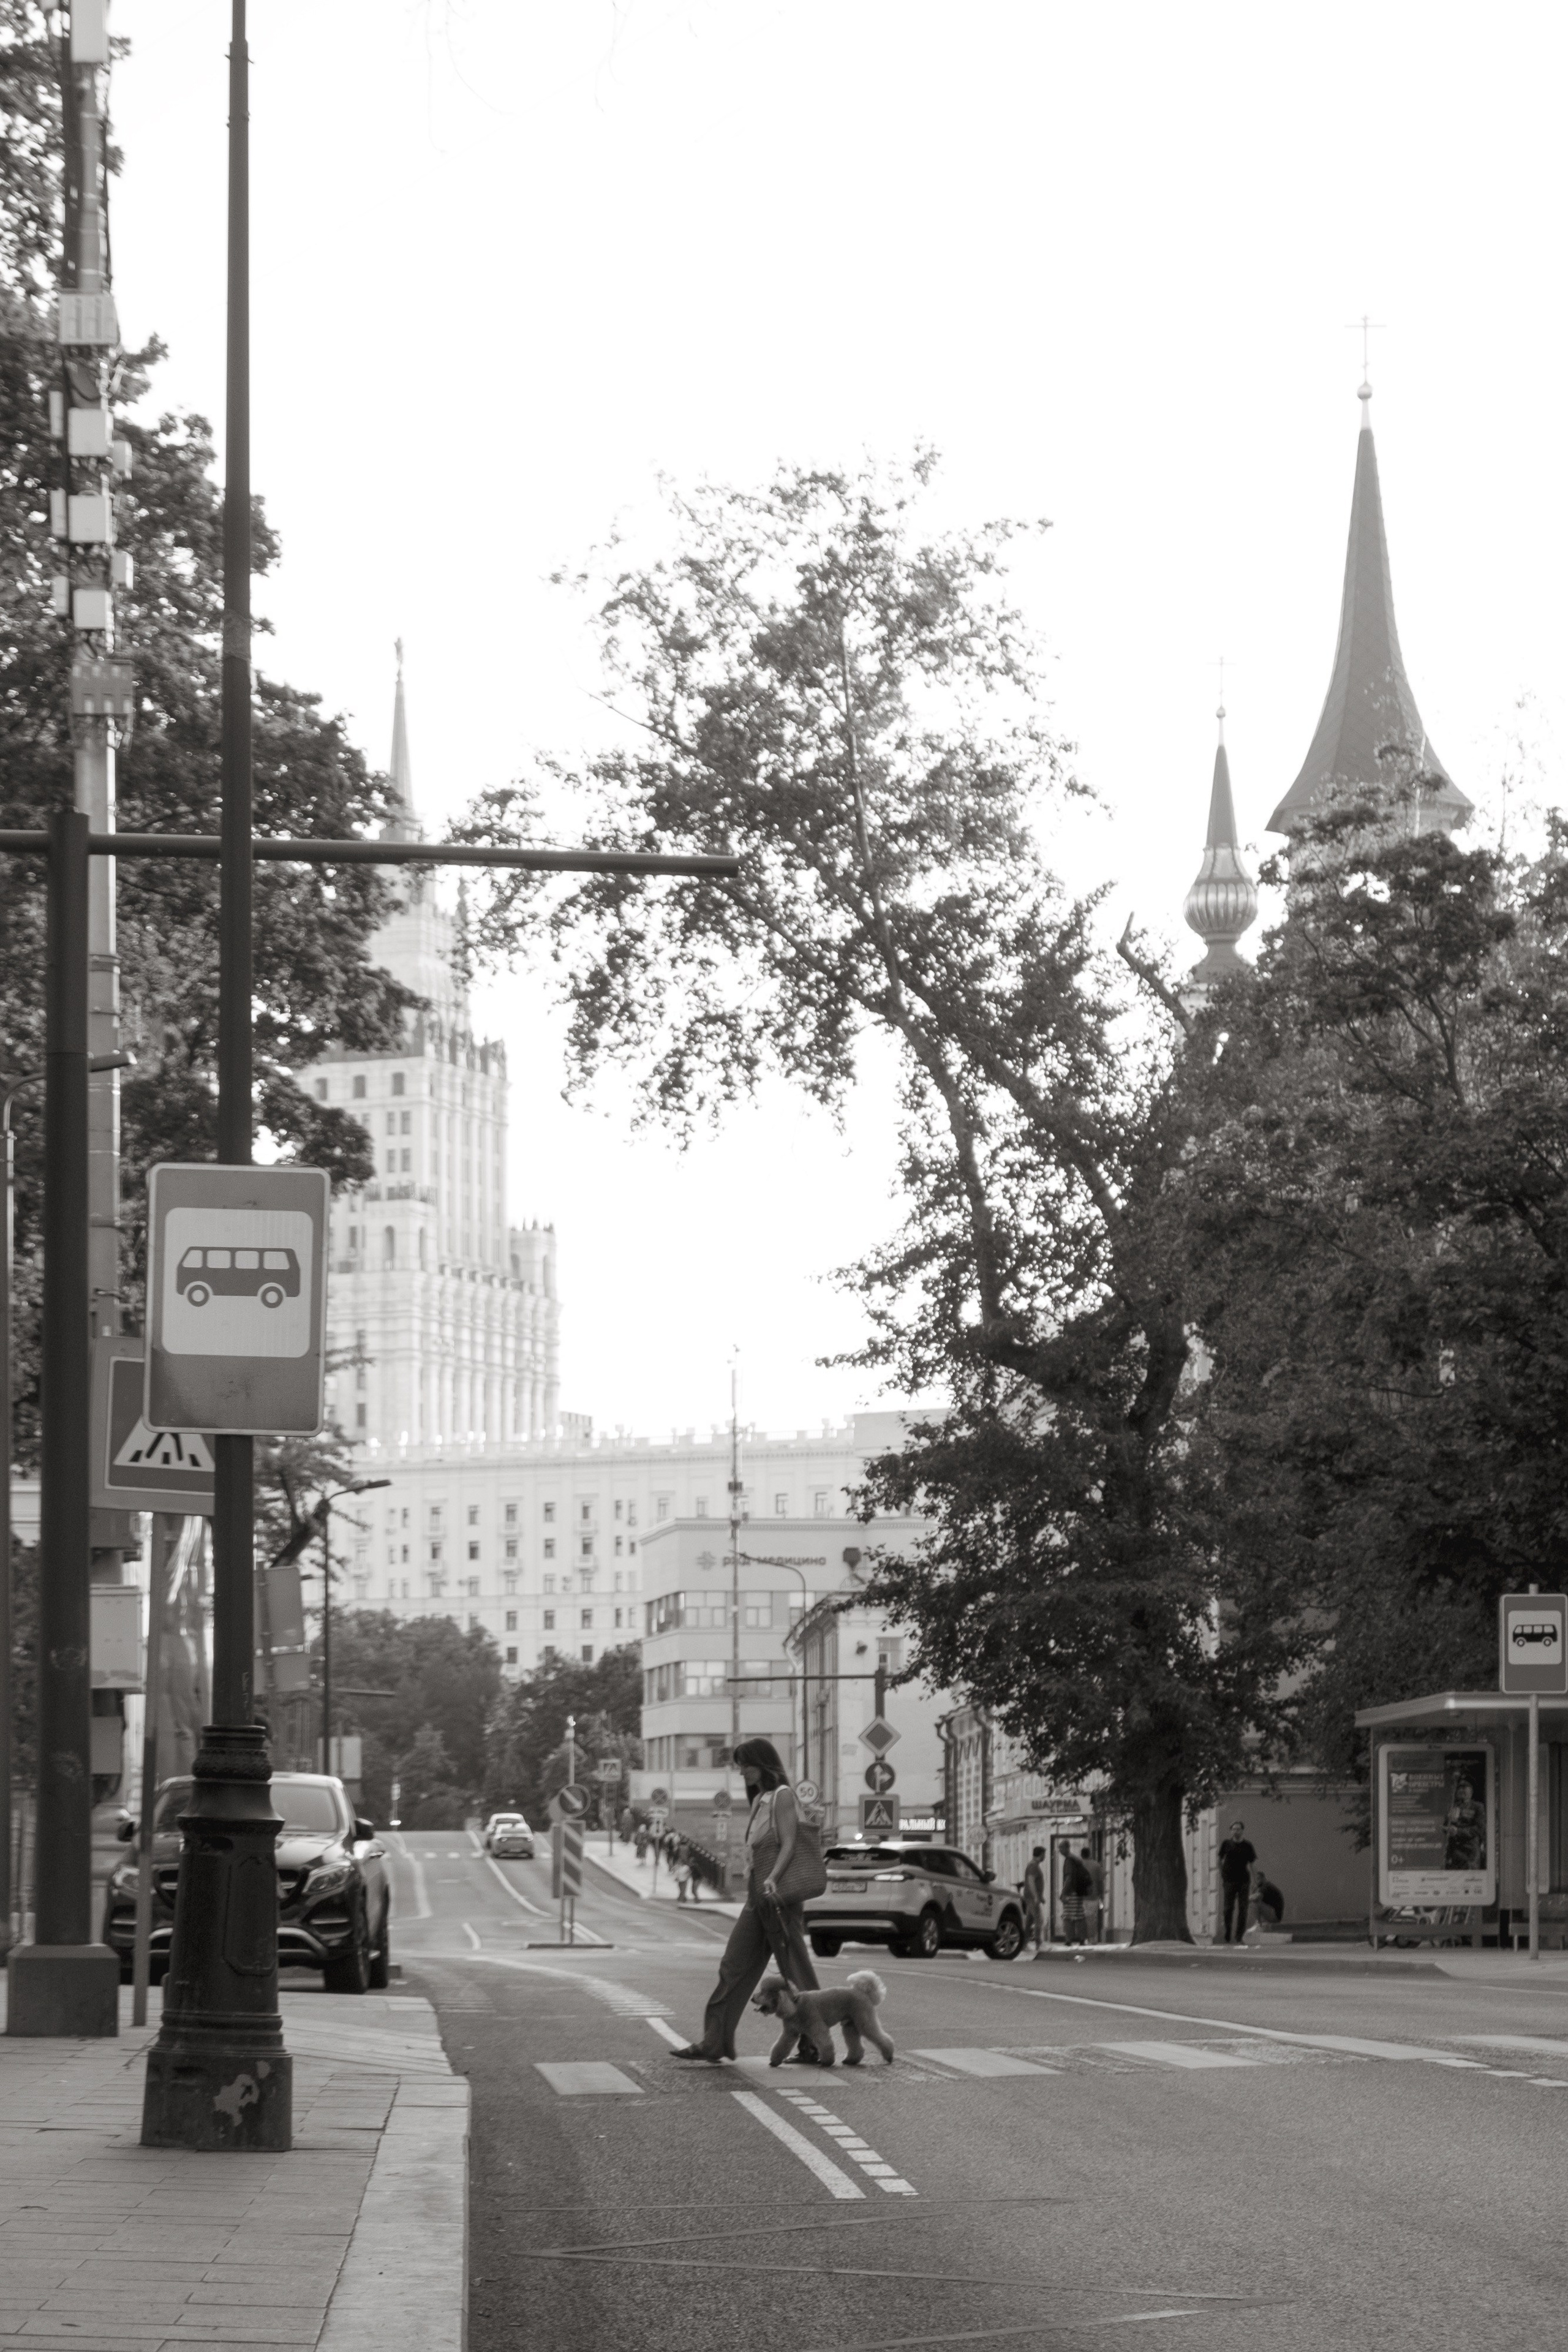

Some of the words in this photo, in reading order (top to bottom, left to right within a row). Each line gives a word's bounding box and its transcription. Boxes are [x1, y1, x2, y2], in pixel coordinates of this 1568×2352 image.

[800, 1787, 814, 1798] 50
[1031, 1799, 1079, 1810] ШАУРМА
[899, 1817, 935, 1830] РАЛЬНЫЙ
[1391, 1854, 1404, 1864] 0+
